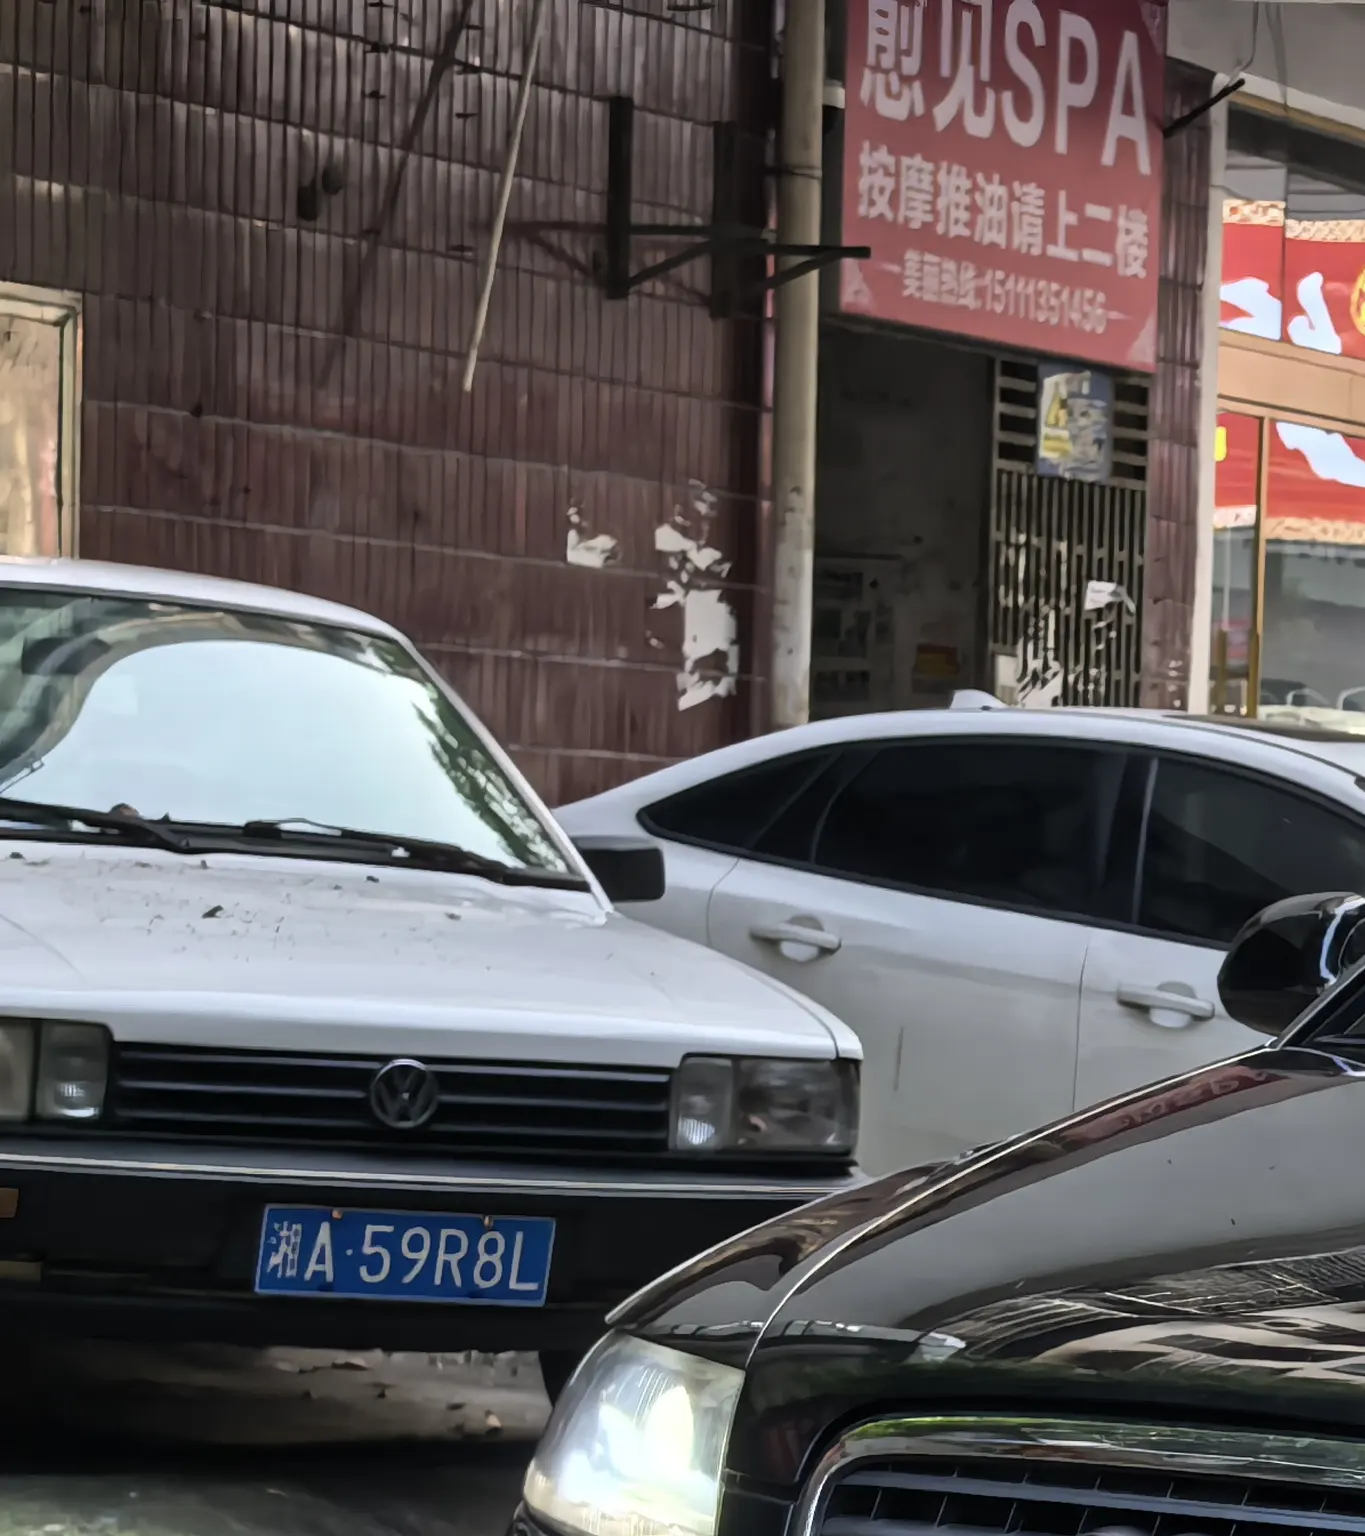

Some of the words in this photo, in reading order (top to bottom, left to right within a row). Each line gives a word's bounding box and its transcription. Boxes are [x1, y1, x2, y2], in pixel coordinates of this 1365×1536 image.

[857, 139, 1149, 279] 按摩推油请上二楼
[267, 1221, 539, 1290] 湘A·59R8L
